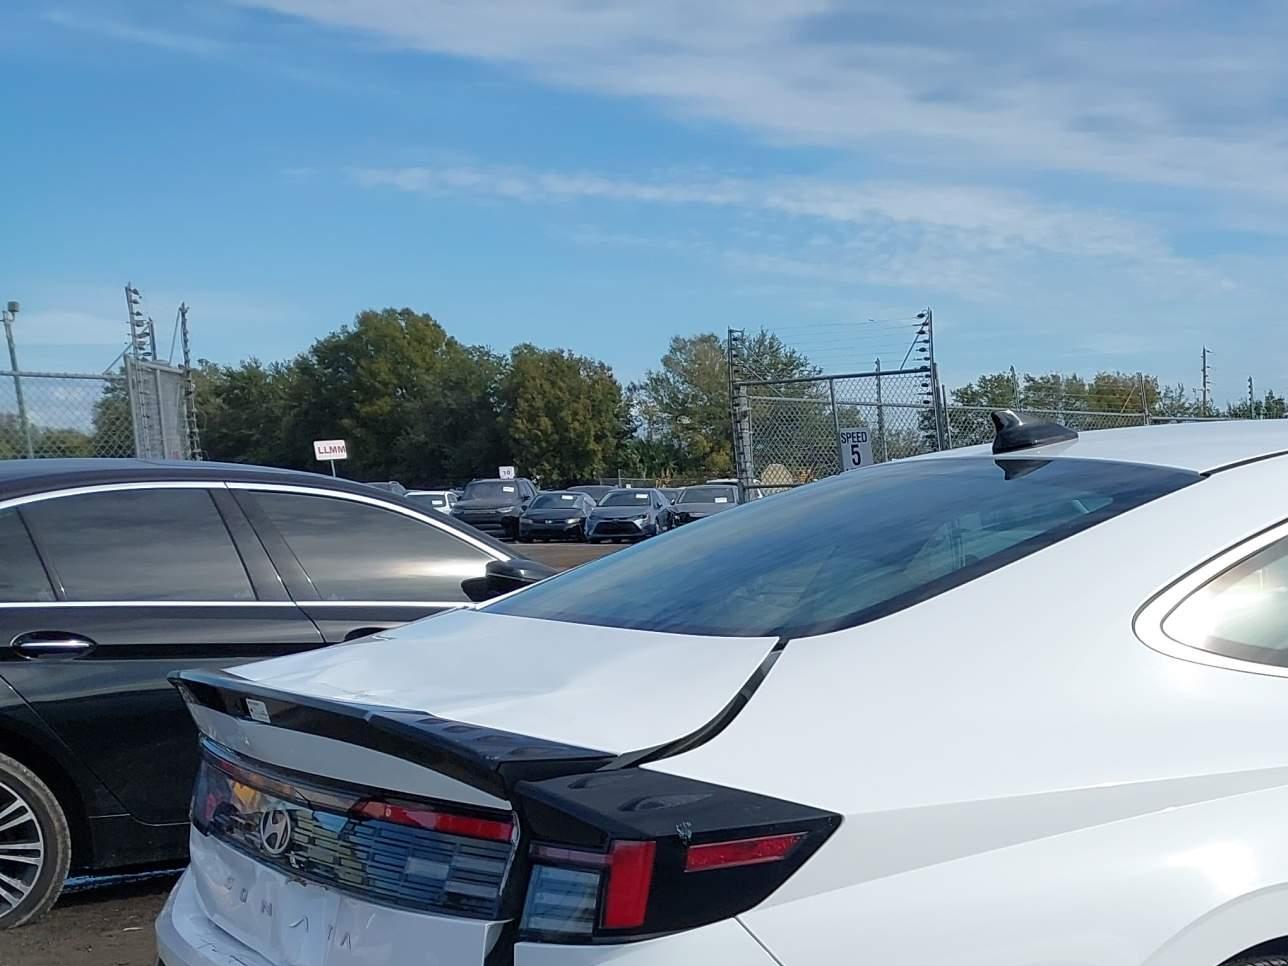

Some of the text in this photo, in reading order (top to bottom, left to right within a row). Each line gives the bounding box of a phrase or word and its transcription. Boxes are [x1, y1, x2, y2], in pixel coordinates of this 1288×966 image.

[840, 431, 868, 444] SPEED
[317, 445, 346, 455] LLMM
[851, 444, 862, 466] 5
